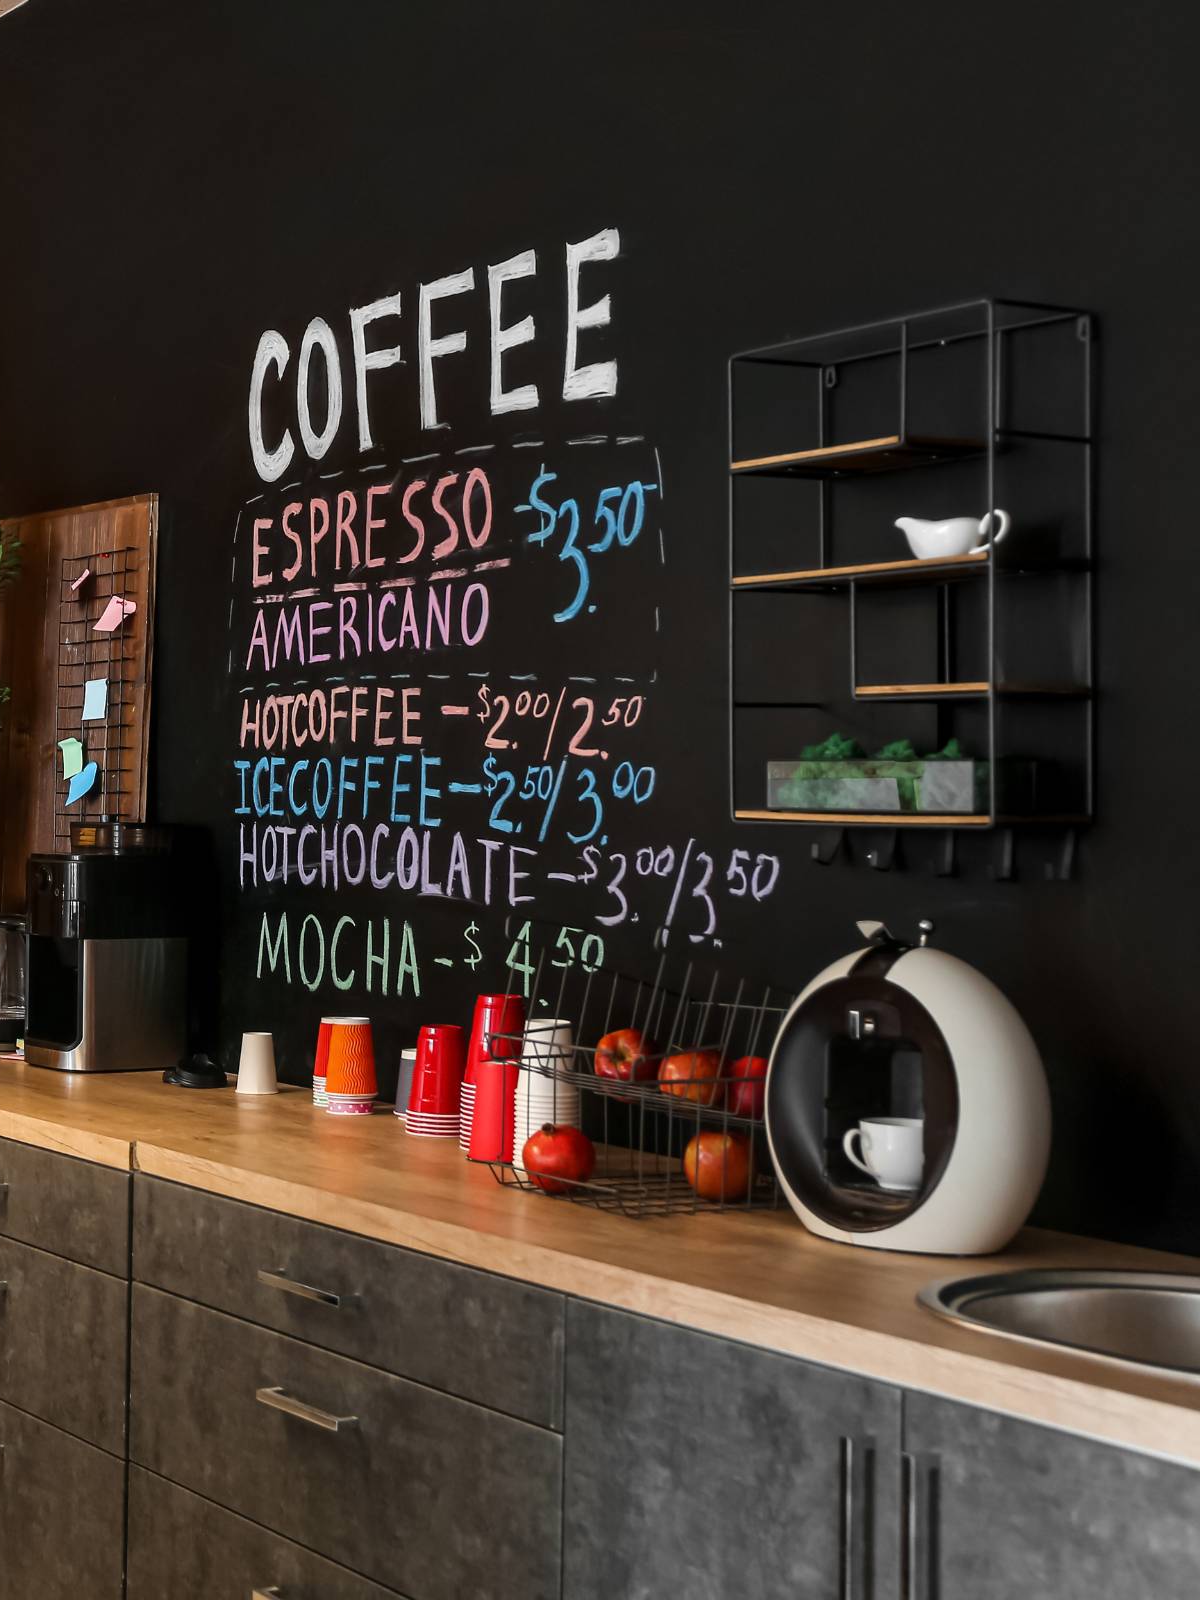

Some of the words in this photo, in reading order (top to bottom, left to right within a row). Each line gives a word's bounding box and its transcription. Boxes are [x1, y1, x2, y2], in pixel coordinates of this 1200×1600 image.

[248, 228, 620, 483] COFFEE
[252, 467, 493, 588] ESPRESSO
[246, 583, 489, 672] AMERICANO
[256, 911, 421, 997] MOCHA
